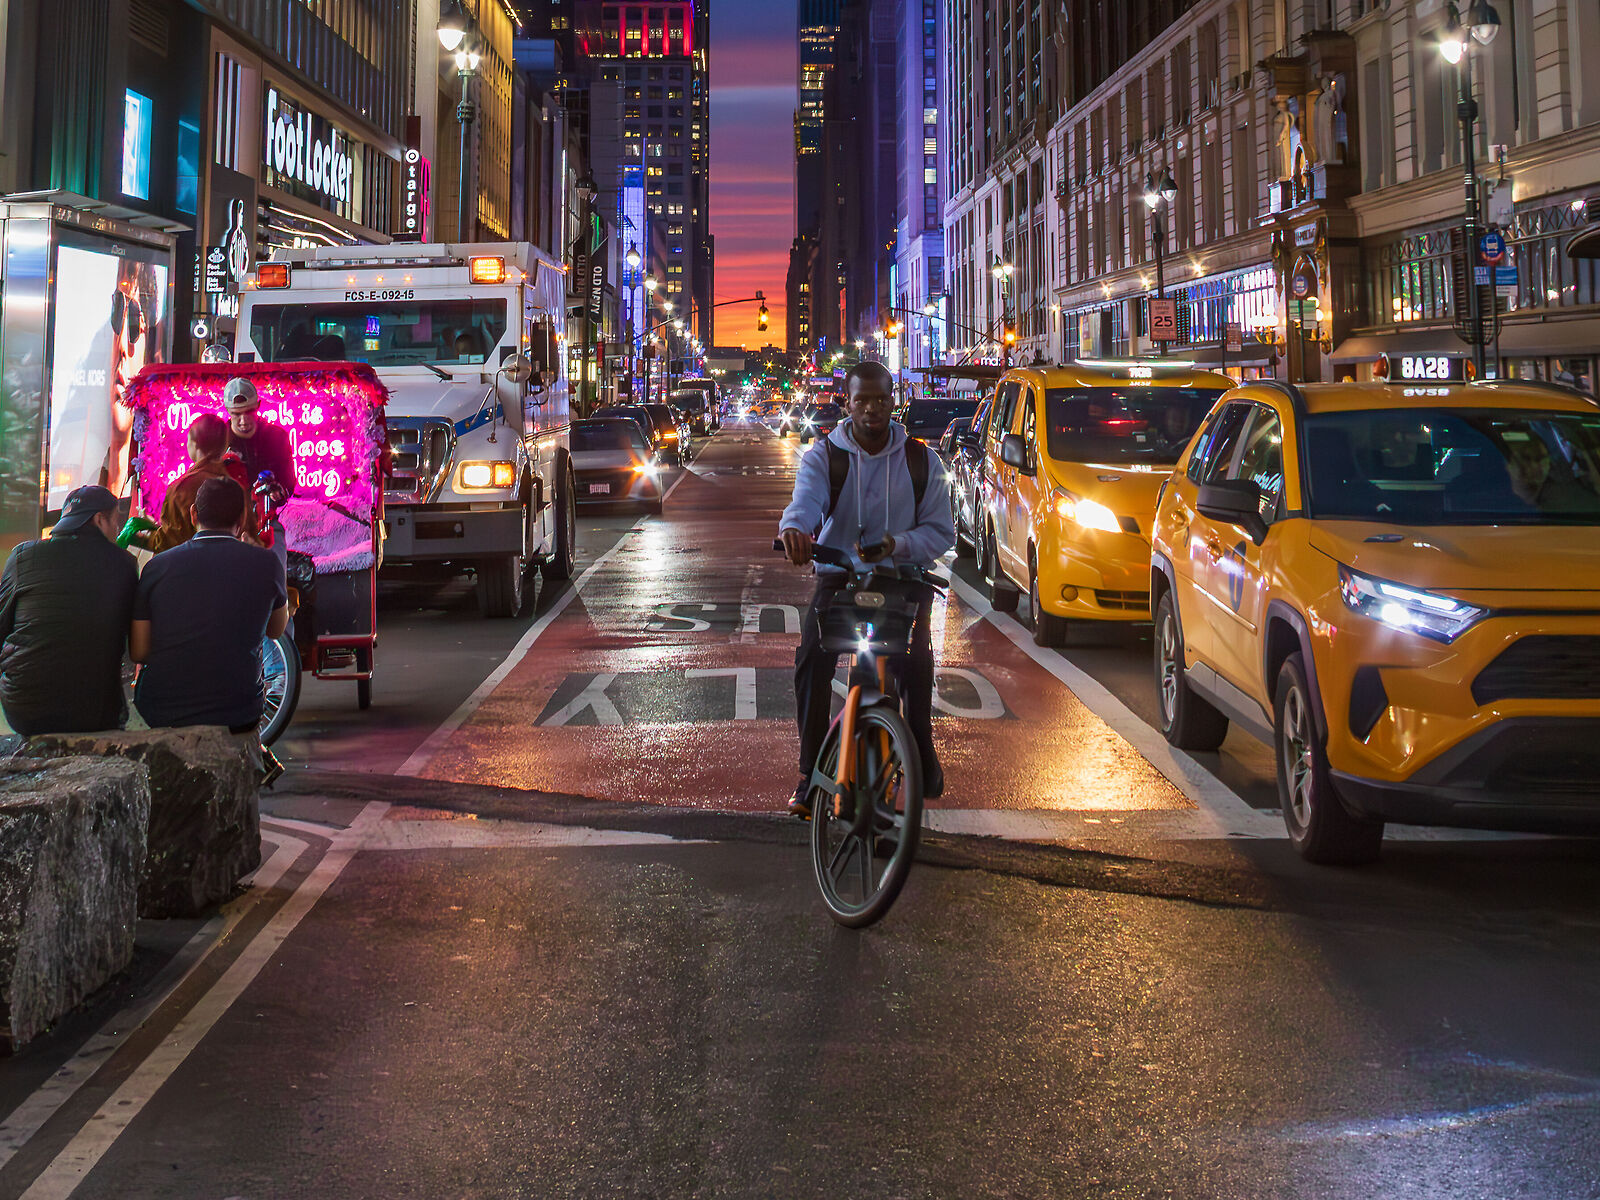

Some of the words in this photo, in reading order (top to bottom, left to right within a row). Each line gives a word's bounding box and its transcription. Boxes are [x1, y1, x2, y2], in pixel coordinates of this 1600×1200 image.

[266, 88, 304, 181] Foot
[305, 112, 352, 203] Locker
[406, 165, 417, 233] targe
[592, 266, 603, 286] OLD
[345, 290, 414, 301] FCS-E-092-15
[1154, 316, 1173, 327] 25
[1402, 357, 1449, 378] 8A28
[644, 602, 800, 634] US
[533, 666, 1006, 727] OLY
